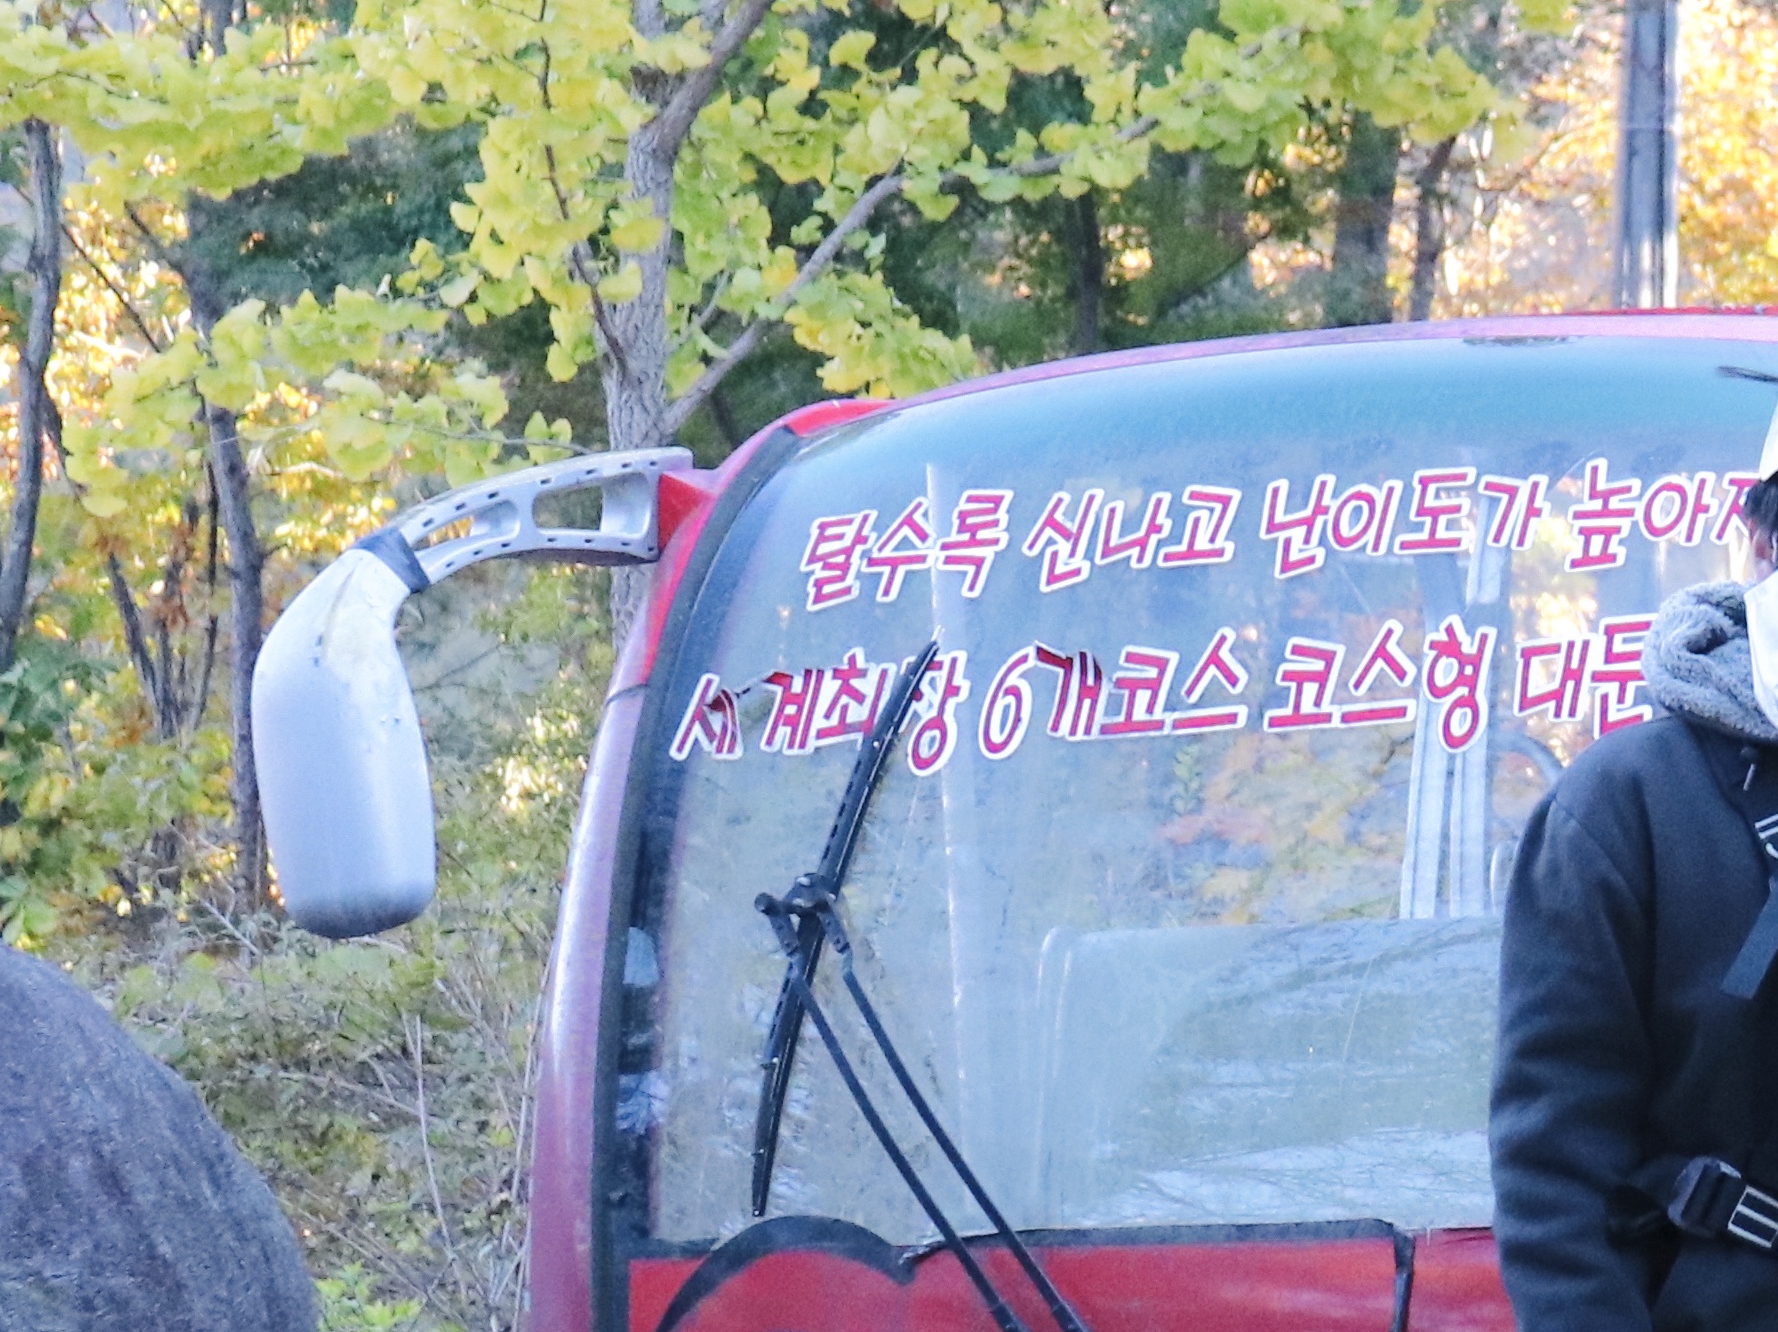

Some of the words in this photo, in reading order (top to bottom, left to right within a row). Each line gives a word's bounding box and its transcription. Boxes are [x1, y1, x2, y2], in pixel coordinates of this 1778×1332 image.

[800, 489, 1014, 611] 탈수록
[1022, 484, 1241, 593] 신나고
[1262, 466, 1549, 579] 난이도가
[1264, 615, 1497, 752] 코스형
